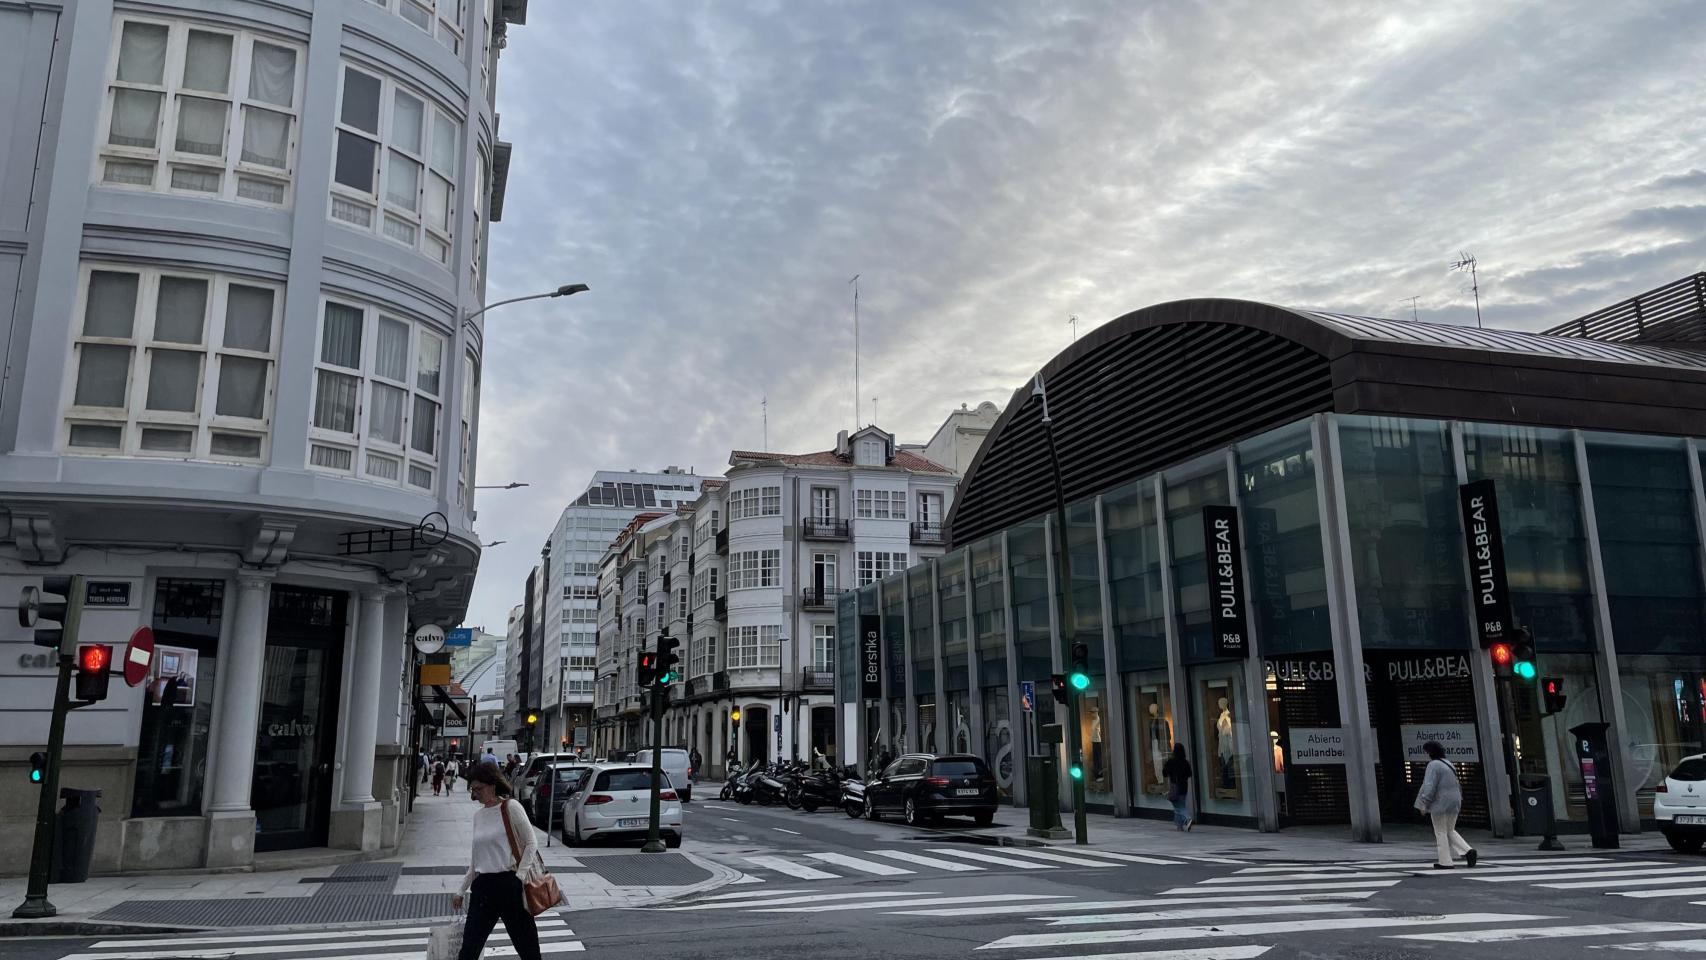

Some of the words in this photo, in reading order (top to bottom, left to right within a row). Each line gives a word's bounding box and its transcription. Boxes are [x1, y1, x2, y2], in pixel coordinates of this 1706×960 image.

[1471, 495, 1497, 605] PULL&BEAR
[1214, 518, 1237, 618] PULL&BEAR
[1485, 621, 1502, 632] P&B
[416, 633, 443, 642] calvo
[1223, 633, 1241, 643] P&B
[18, 650, 57, 668] cal
[865, 630, 877, 683] Bershka
[1264, 659, 1373, 682] PULL&BR
[1388, 655, 1471, 681] PULL&BEA
[268, 719, 314, 736] calvo
[1416, 730, 1444, 741] Abierto
[1446, 730, 1461, 741] 24h
[1307, 734, 1341, 744] Abierto
